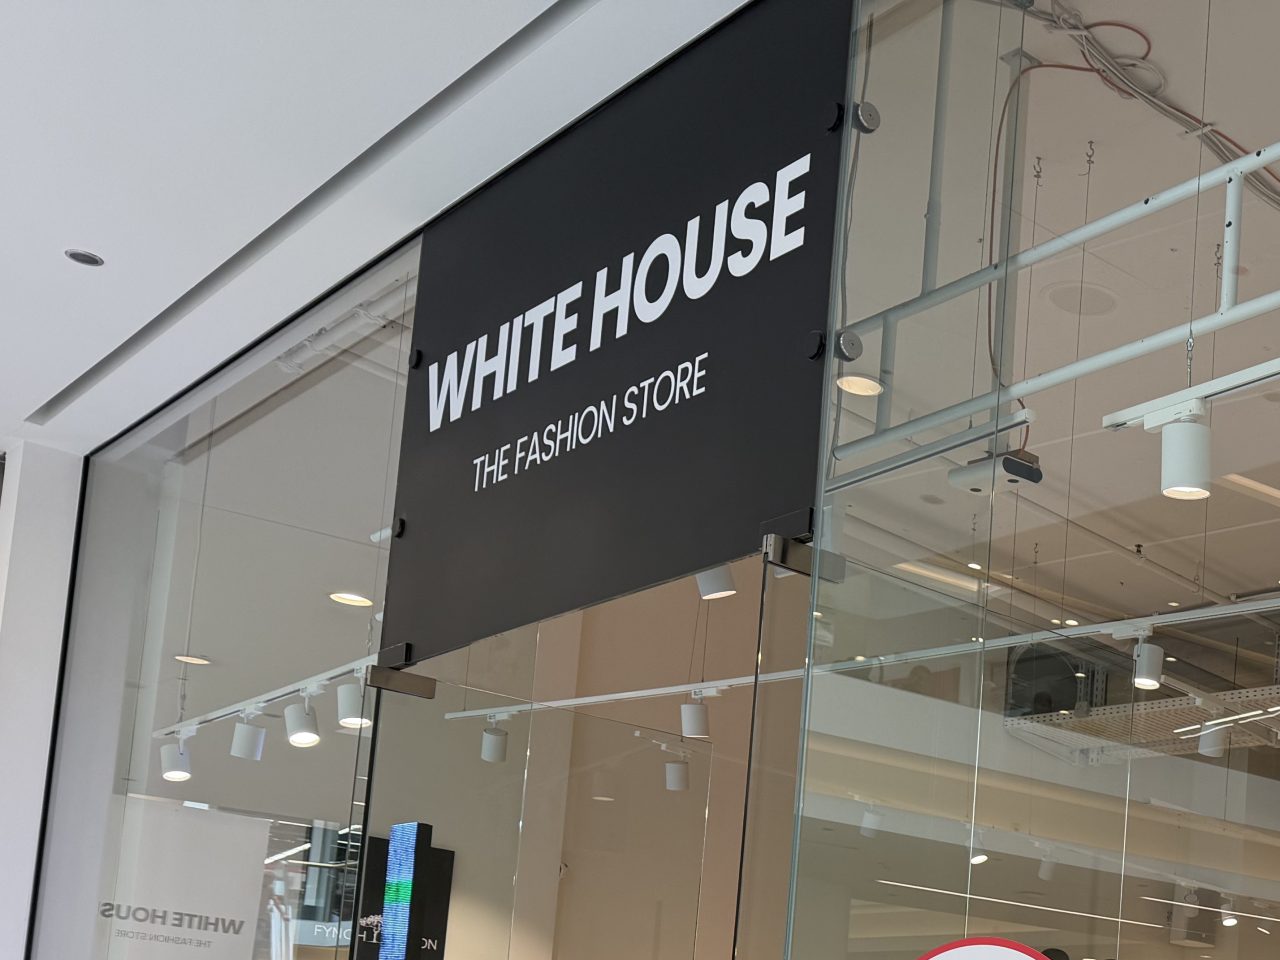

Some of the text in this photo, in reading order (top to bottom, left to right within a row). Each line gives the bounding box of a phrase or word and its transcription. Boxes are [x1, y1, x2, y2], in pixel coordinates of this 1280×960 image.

[428, 152, 812, 432] WHITE HOUSE
[473, 352, 709, 492] THE FASHION STORE
